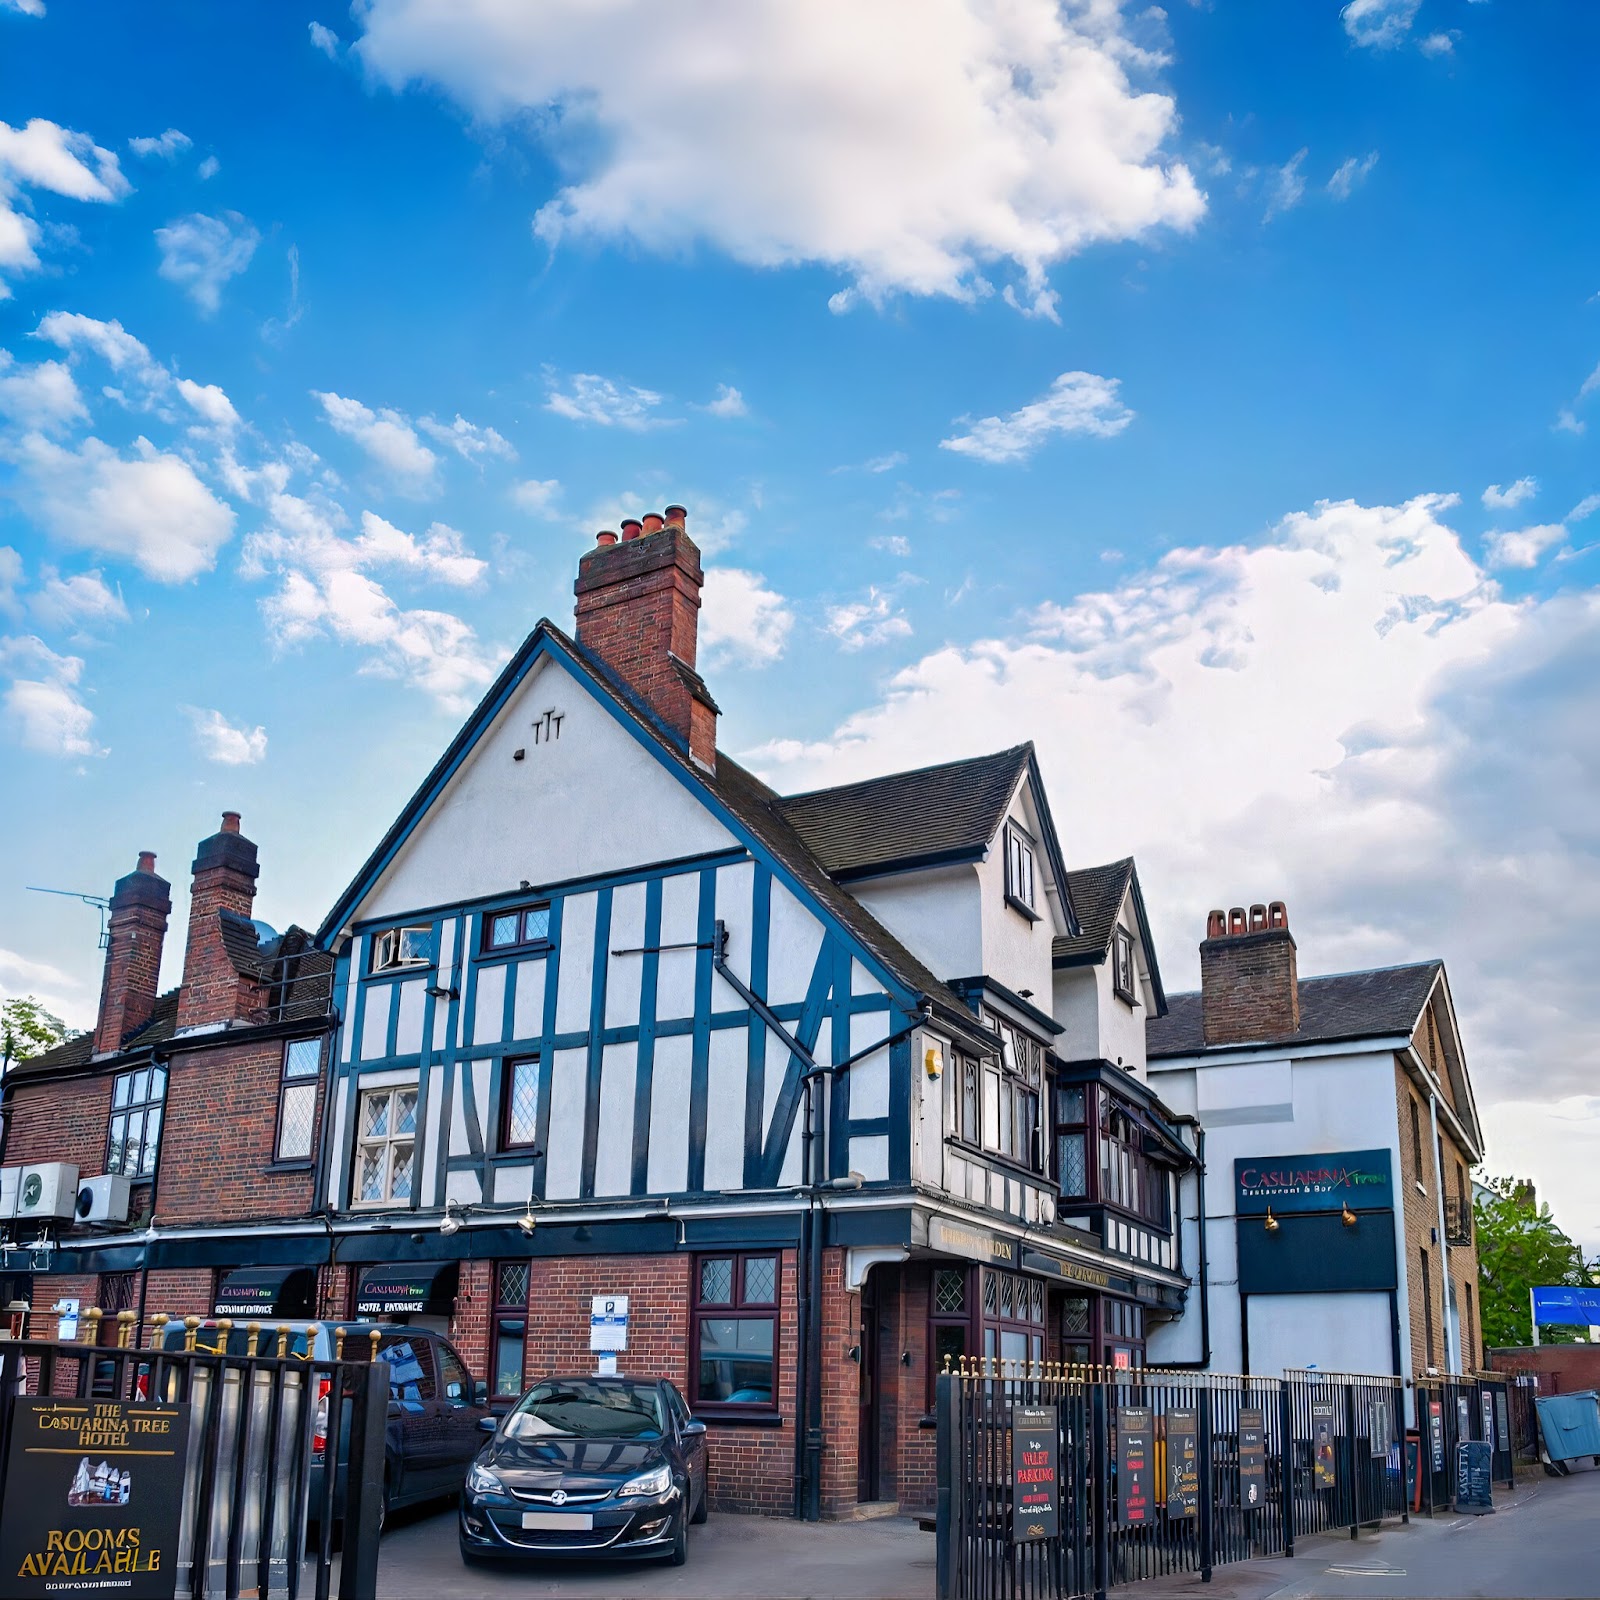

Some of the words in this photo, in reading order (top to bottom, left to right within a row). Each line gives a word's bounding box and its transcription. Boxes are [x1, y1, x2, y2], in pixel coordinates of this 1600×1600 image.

[94, 1404, 121, 1417] THE
[132, 1419, 170, 1433] TREE
[79, 1432, 129, 1446] HOTEL
[47, 1528, 140, 1551] ROOMS
